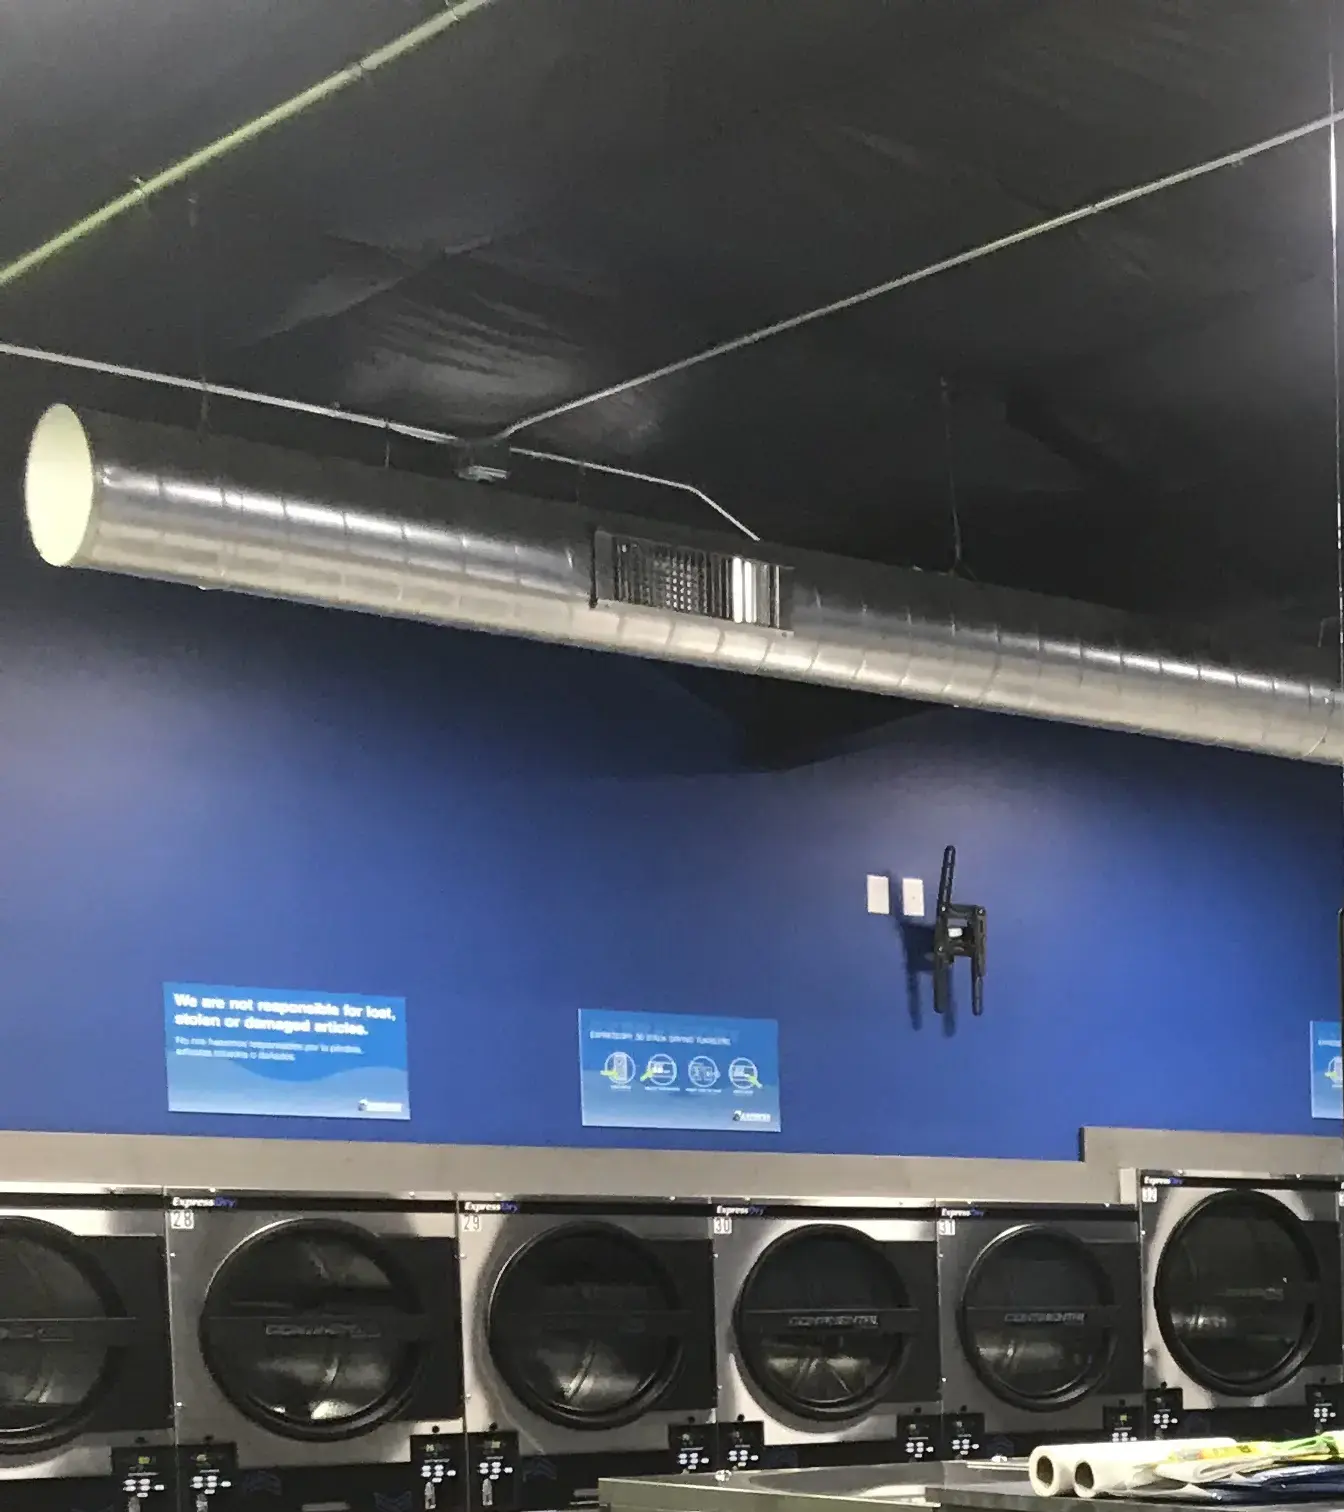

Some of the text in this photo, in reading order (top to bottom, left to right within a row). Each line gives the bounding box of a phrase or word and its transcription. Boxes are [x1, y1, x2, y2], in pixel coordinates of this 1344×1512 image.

[173, 992, 198, 1008] We
[200, 996, 225, 1009] are
[229, 999, 254, 1012] not
[257, 1000, 340, 1016] responsible
[342, 1003, 363, 1018] for
[174, 1013, 221, 1027] stolen
[223, 1017, 241, 1028] or
[243, 1016, 311, 1034] damaged
[173, 1208, 193, 1228] 28
[463, 1213, 481, 1231] 29
[715, 1217, 731, 1233] 30
